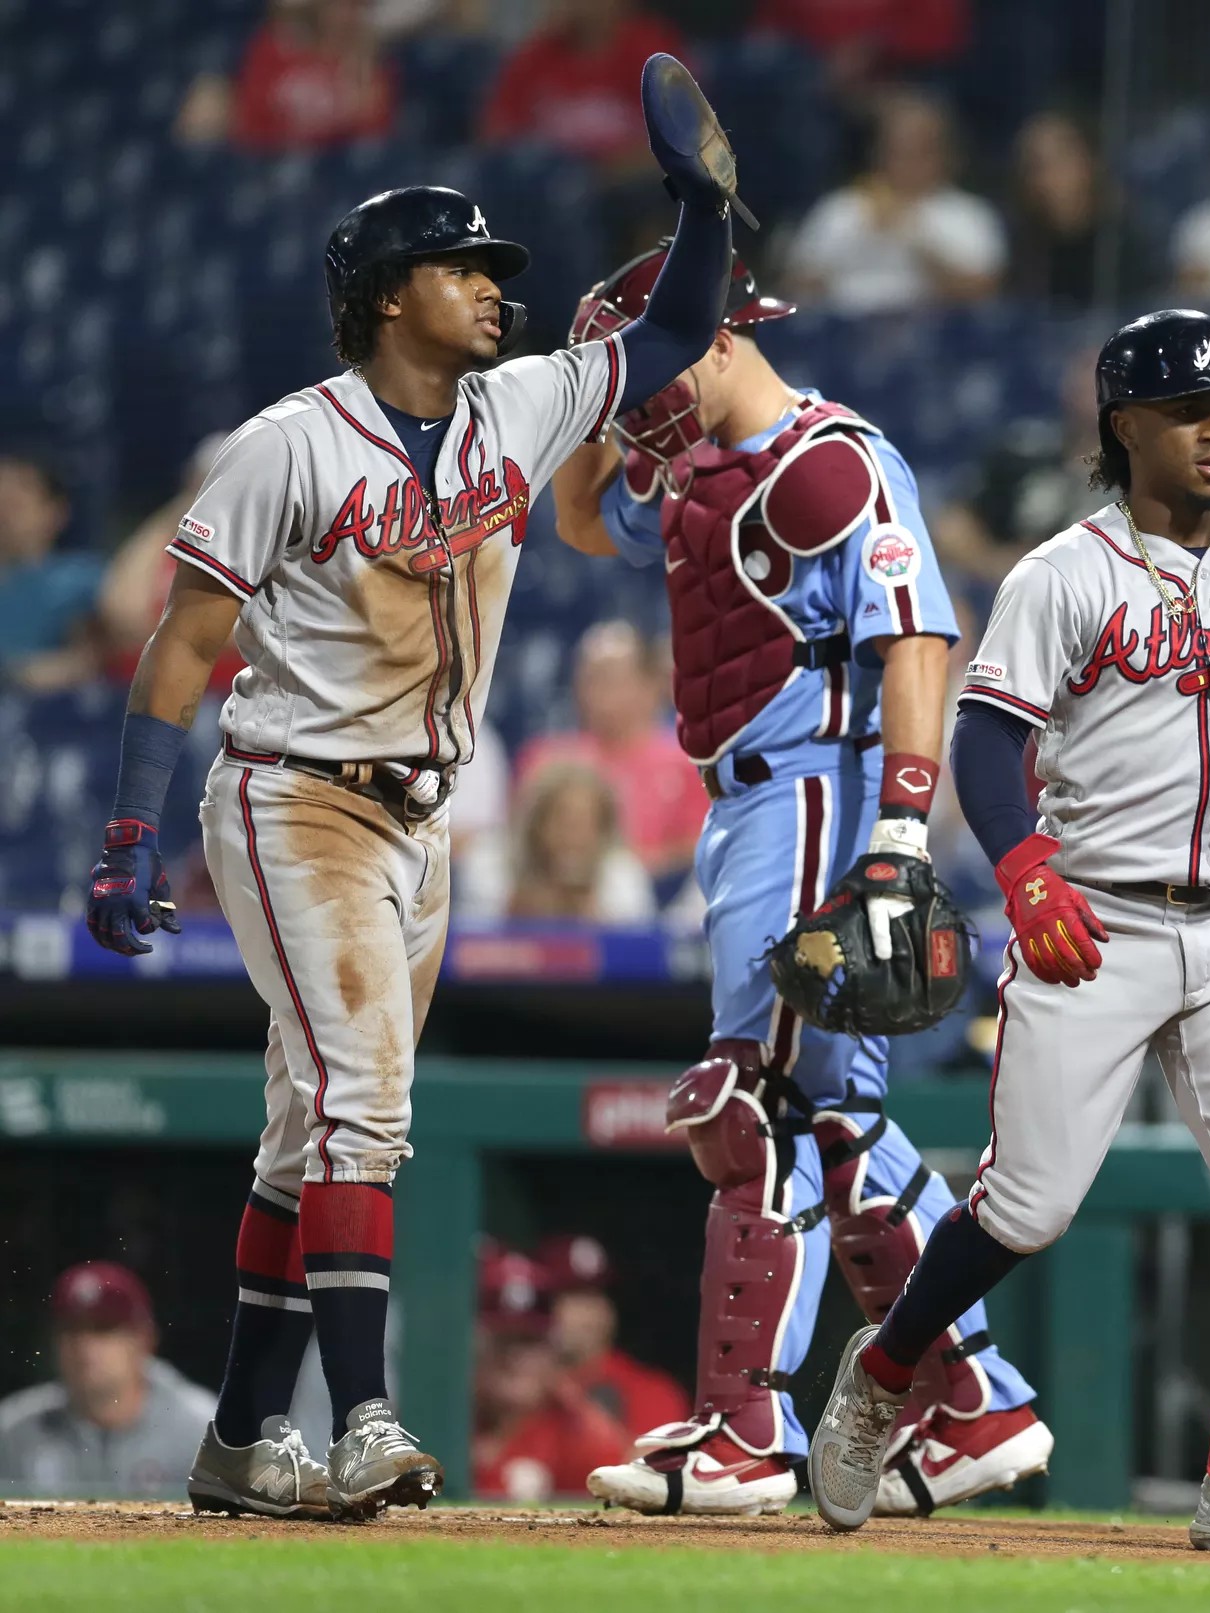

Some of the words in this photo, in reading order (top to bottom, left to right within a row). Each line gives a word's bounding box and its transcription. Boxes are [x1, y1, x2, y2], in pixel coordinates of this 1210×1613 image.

[466, 205, 491, 239] A
[311, 438, 501, 565] Atlana
[359, 1408, 392, 1422] balance
[365, 1402, 383, 1412] new
